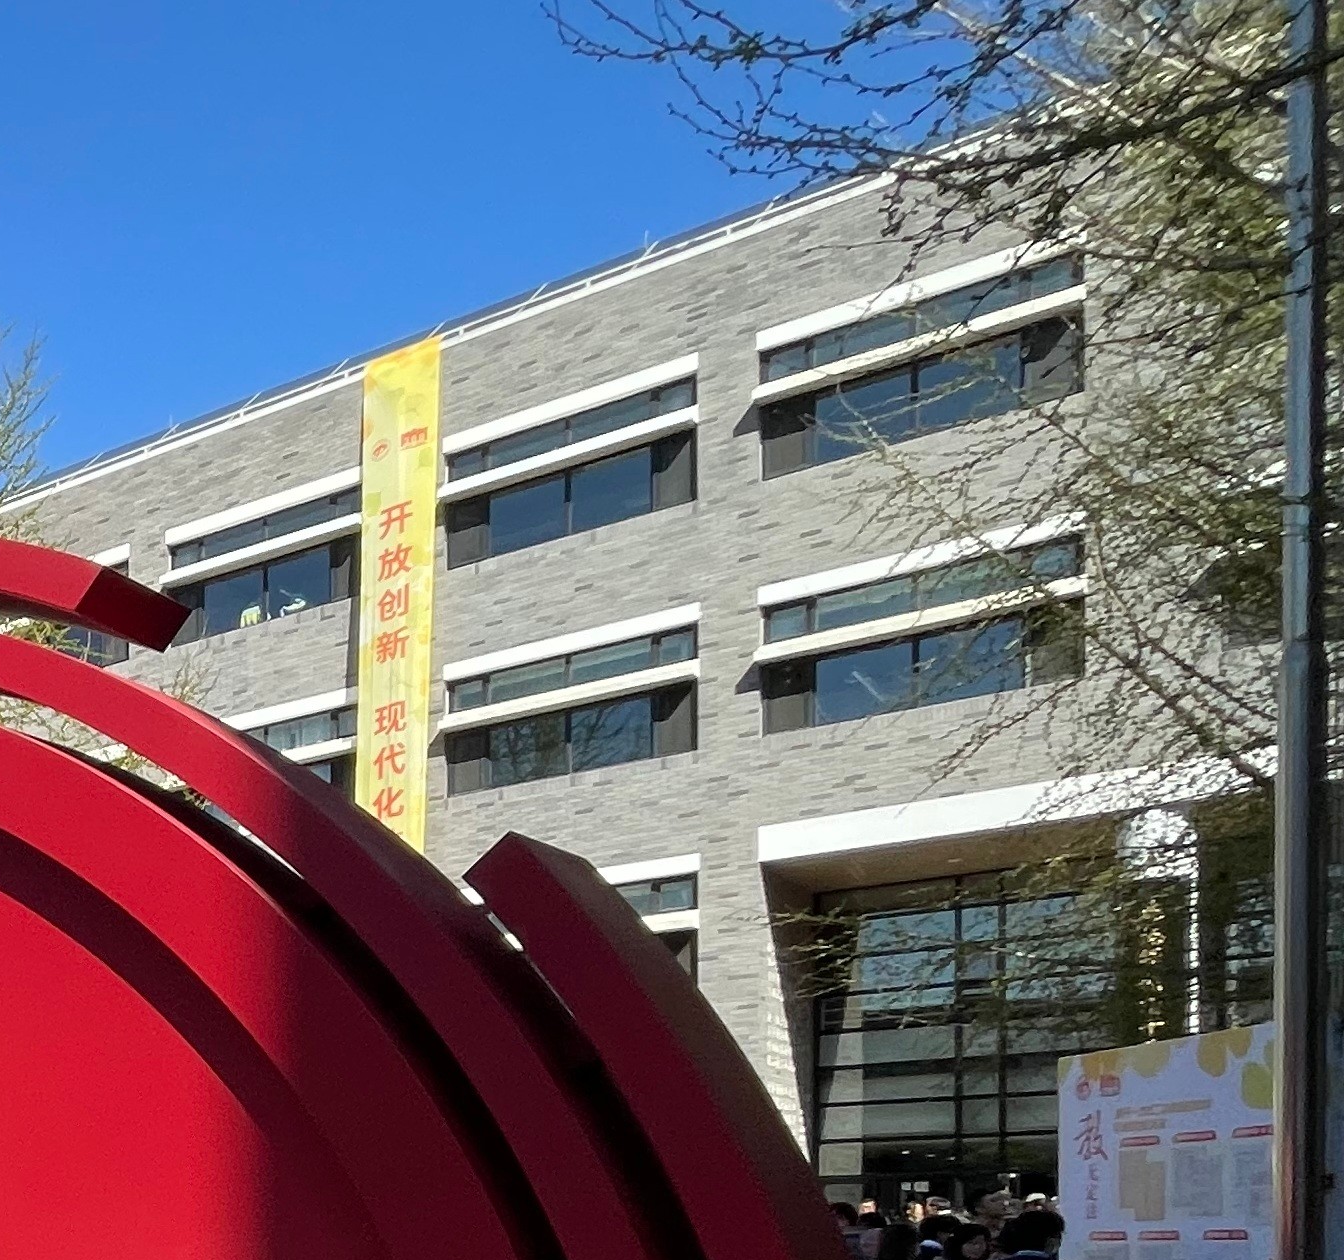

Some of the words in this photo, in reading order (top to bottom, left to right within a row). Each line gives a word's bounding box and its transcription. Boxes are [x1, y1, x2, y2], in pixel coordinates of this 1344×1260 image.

[376, 500, 414, 664] 开放创新
[372, 700, 408, 836] 现代化
